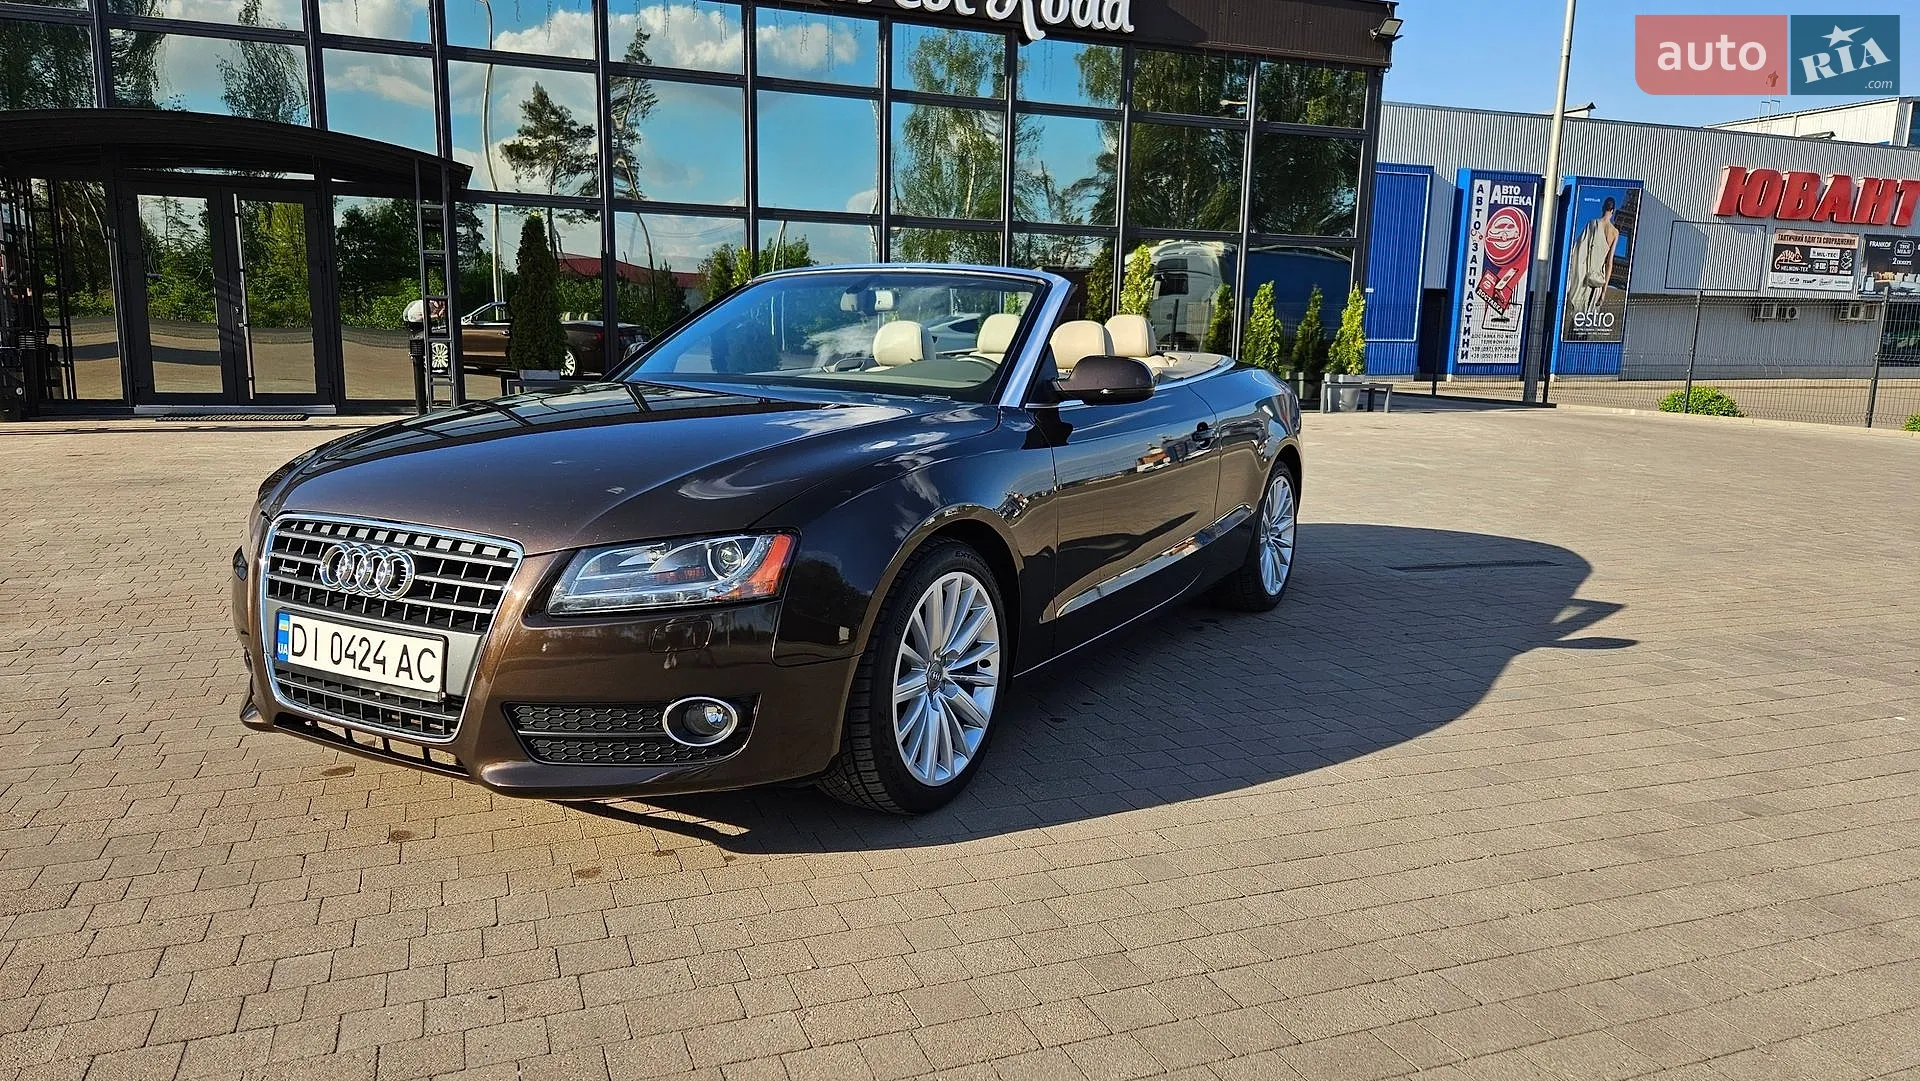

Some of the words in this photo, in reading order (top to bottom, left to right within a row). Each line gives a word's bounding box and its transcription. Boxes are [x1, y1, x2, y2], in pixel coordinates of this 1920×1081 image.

[1476, 288, 1504, 313] ДОСТАВКА
[1574, 309, 1614, 327] estro
[278, 643, 288, 655] UA
[291, 622, 318, 662] DI
[330, 631, 387, 676] 0424
[395, 643, 437, 684] AC
